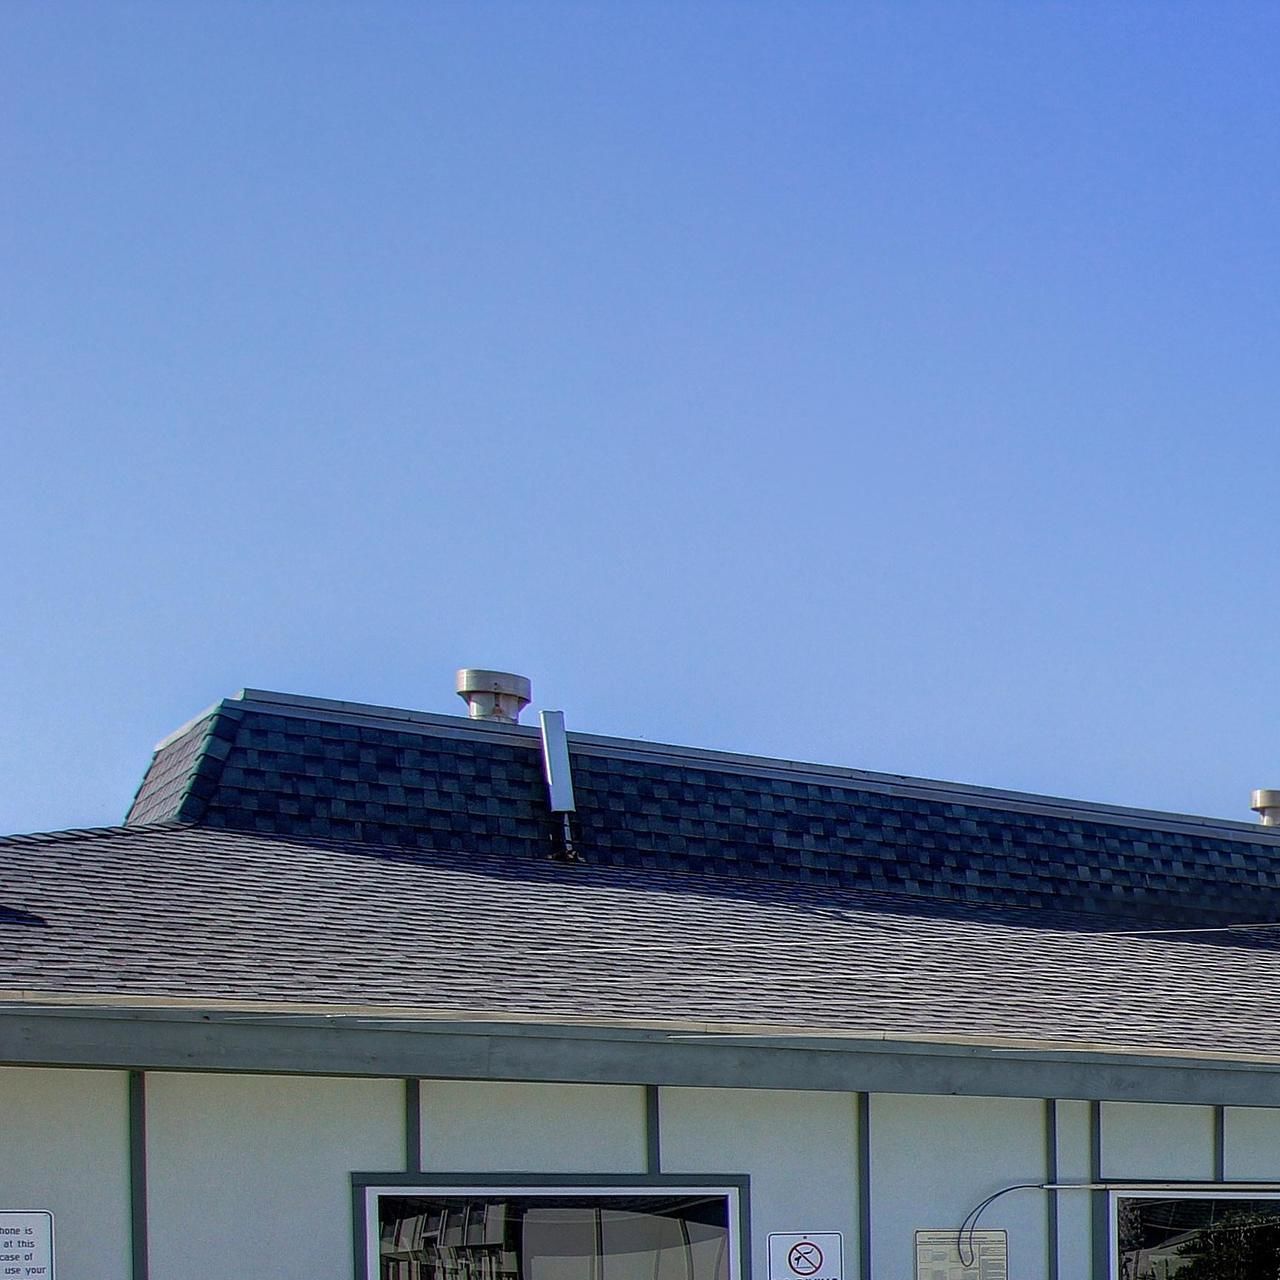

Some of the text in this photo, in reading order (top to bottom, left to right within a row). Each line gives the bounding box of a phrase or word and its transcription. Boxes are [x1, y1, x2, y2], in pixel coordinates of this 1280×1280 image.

[25, 1226, 33, 1235] is
[4, 1240, 35, 1248] at this
[24, 1252, 33, 1261] of
[25, 1266, 46, 1276] your
